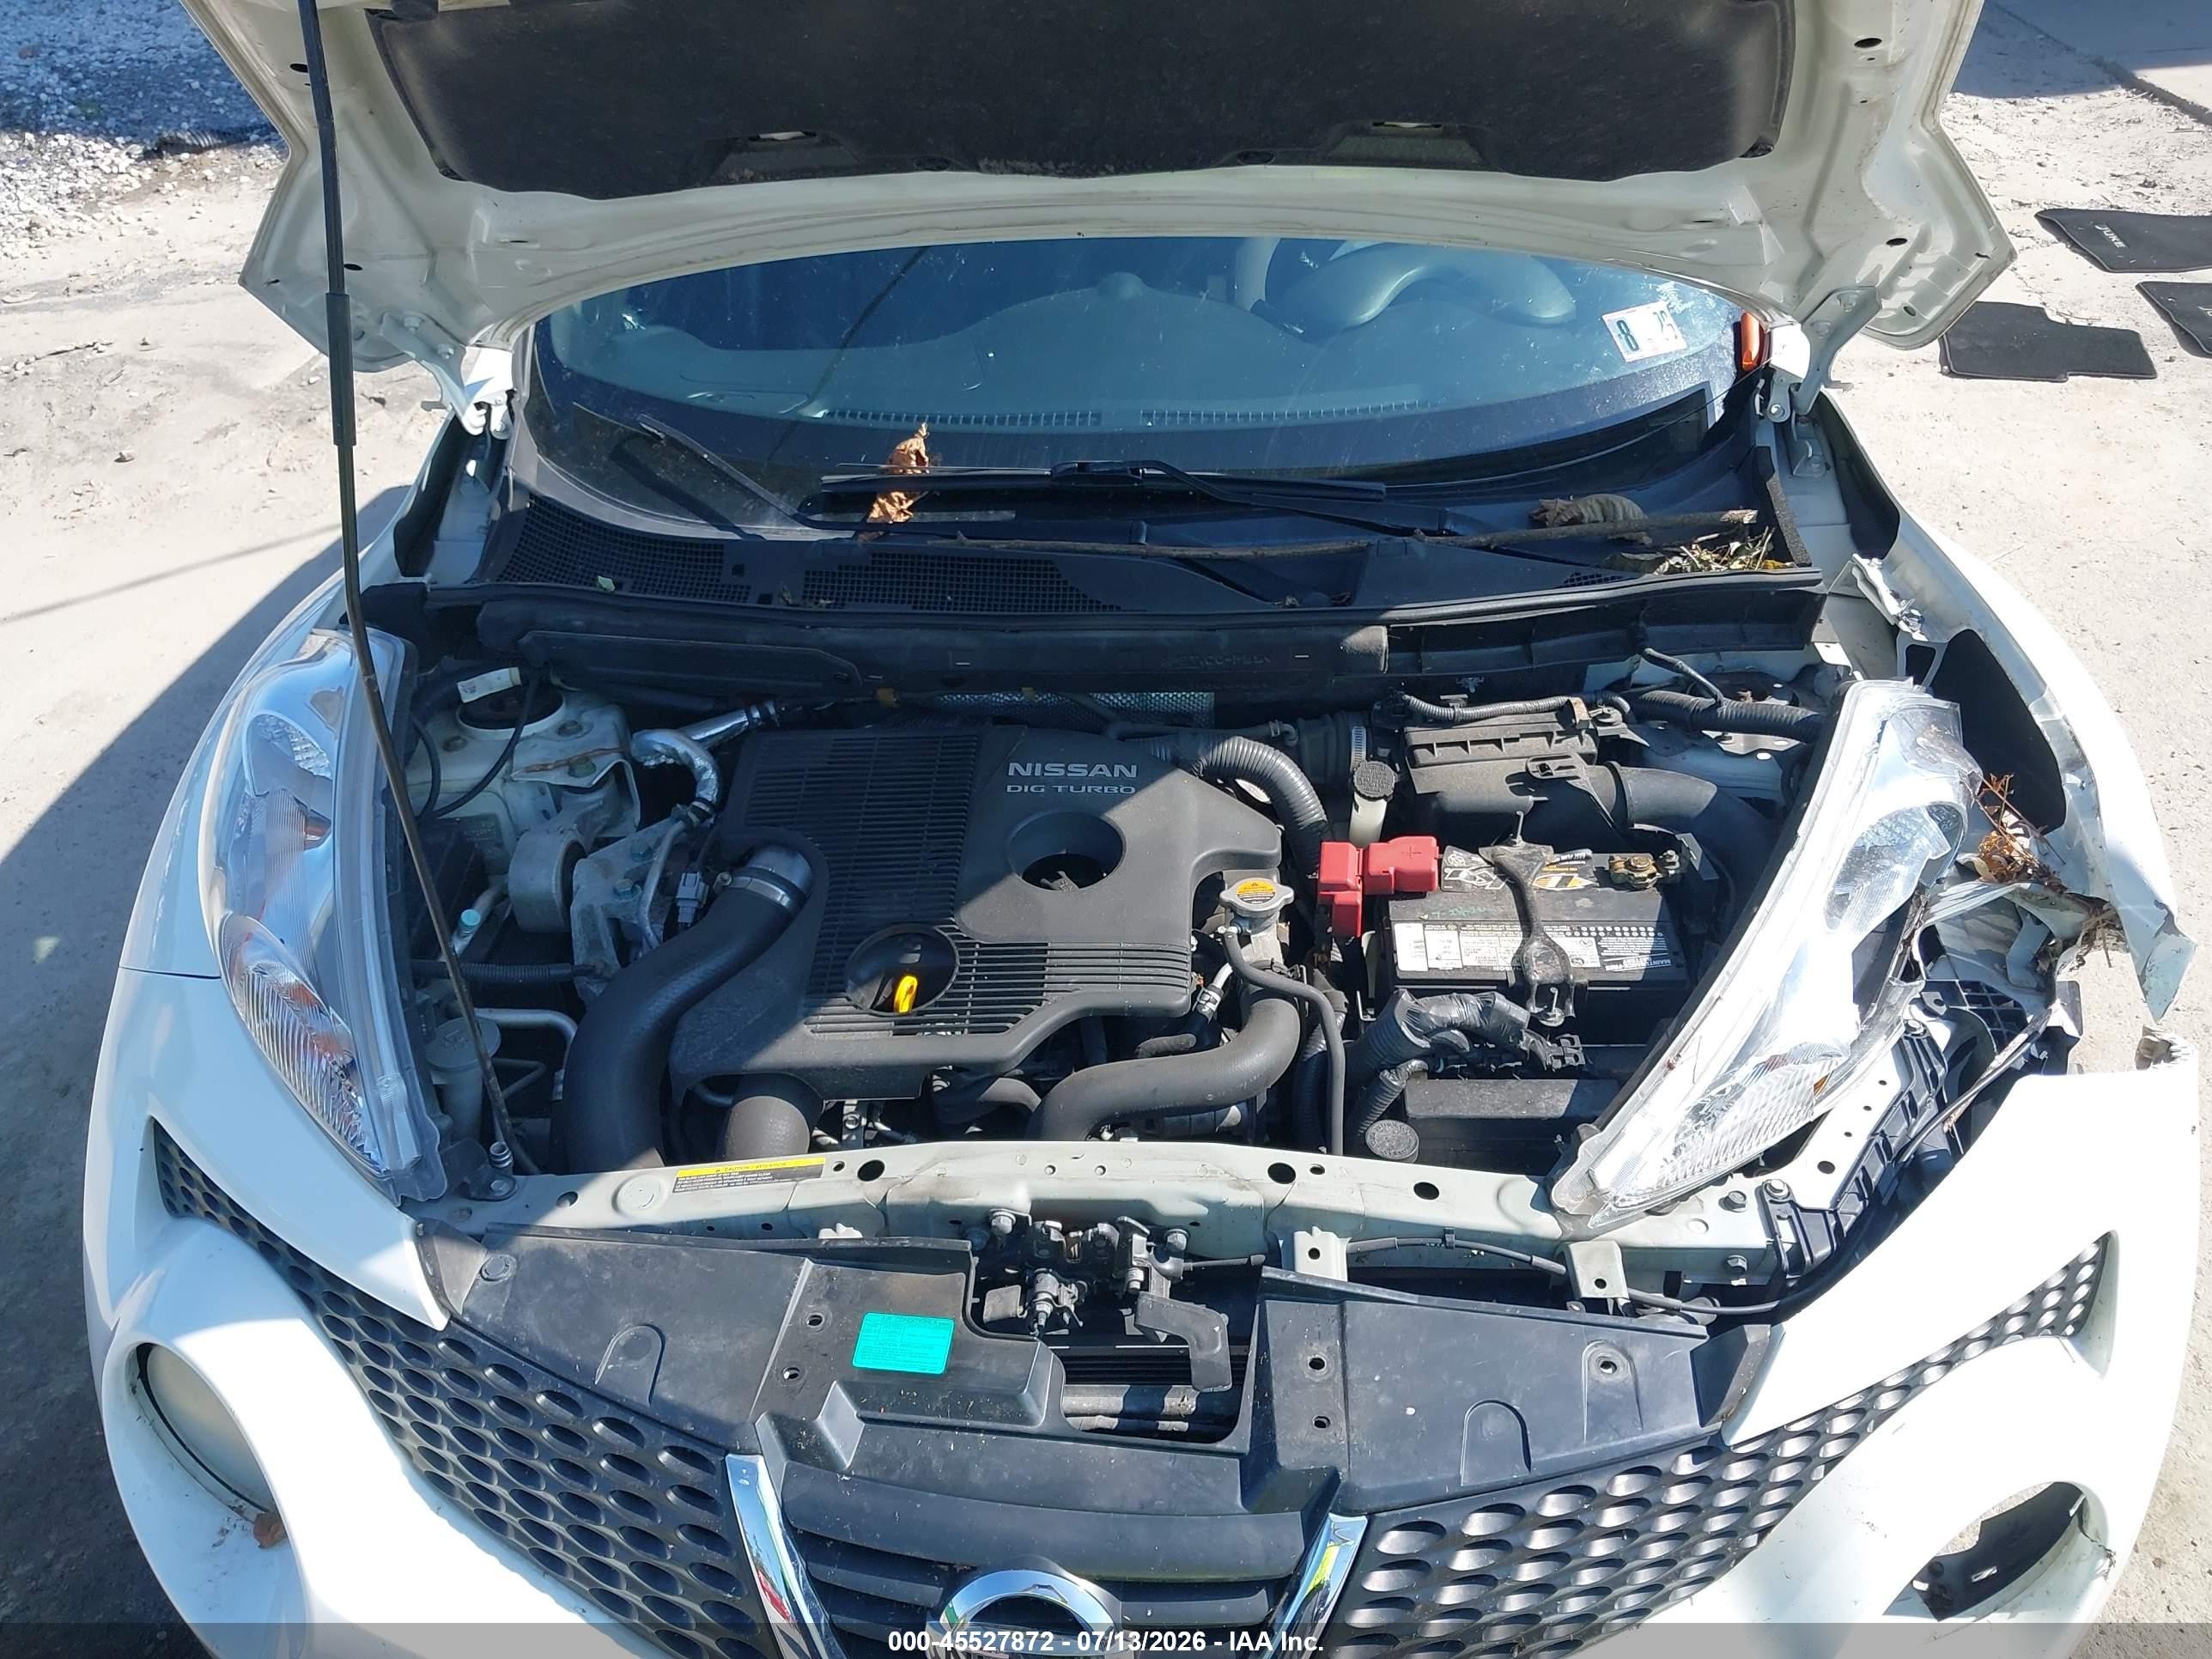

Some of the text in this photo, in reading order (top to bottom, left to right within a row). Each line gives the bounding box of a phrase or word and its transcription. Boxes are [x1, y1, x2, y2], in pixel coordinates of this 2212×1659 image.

[2094, 224, 2126, 248] JUKE
[1616, 319, 1639, 351] 8
[1008, 763, 1137, 778] NISSAN
[1052, 785, 1136, 794] TURBO
